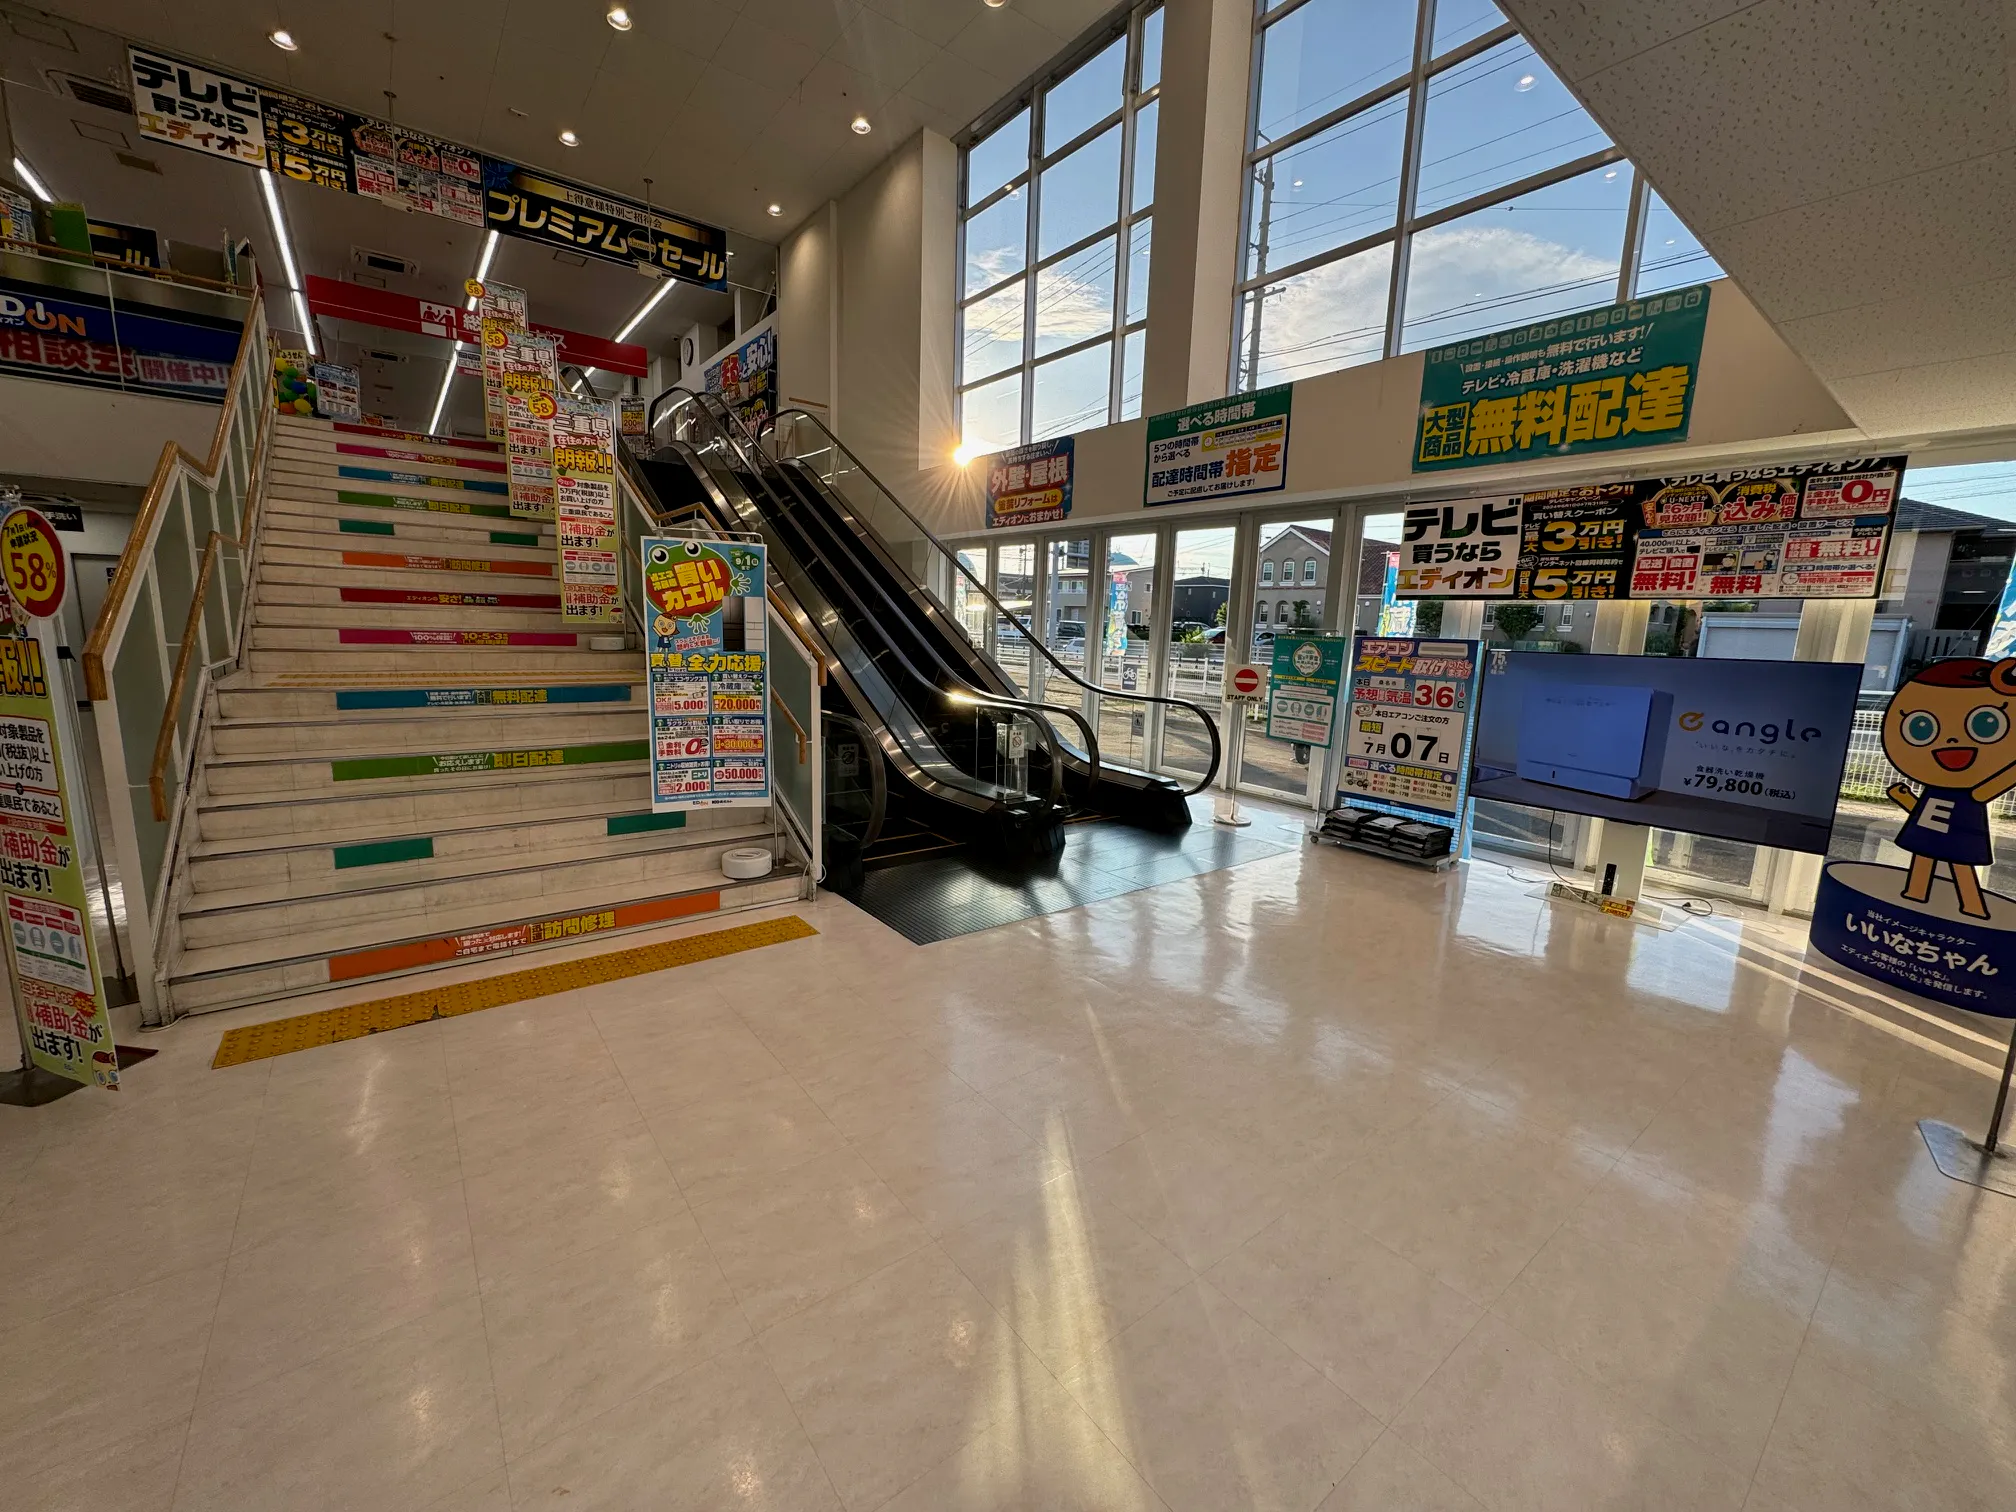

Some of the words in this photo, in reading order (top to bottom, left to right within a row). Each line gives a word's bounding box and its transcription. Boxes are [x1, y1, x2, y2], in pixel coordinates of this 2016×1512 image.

[132, 54, 260, 120] テレビ
[151, 92, 249, 136] 買うなら
[139, 110, 266, 161] エディオン
[281, 118, 309, 146] 3
[282, 152, 313, 182] 5
[487, 189, 628, 256] プレミアム
[656, 238, 726, 281] セール
[502, 344, 554, 368] 三重県
[1460, 345, 1645, 395] テレビ・冷蔵庫・洗濯機など
[1177, 400, 1257, 433] 選べる時間帯
[1426, 405, 1466, 436] 大型
[1465, 364, 1689, 458] 無料配達
[552, 412, 613, 439] 三重県
[508, 443, 542, 457] 出ます!
[1153, 435, 1200, 453] 5つの時間帯
[1153, 449, 1191, 464] から選べる
[1423, 430, 1461, 461] 商品
[553, 446, 614, 475] 朗報!!
[991, 455, 1069, 496] 外壁・屋根
[512, 500, 545, 513] 出ます!
[1523, 483, 1636, 505] 期間限定でおトク!!
[1404, 497, 1522, 542] テレビ
[1532, 507, 1619, 521] 買い替えクーポン
[1721, 496, 1779, 523] 込み
[561, 534, 599, 548] 出ます!
[1541, 519, 1577, 553] 3
[1578, 518, 1625, 538] 万円
[1412, 541, 1502, 565] 買うなら
[1577, 533, 1624, 551] 引き!
[10, 551, 58, 593] 58%
[673, 558, 722, 590] 買い
[1396, 567, 1515, 590] エディオン
[1531, 567, 1569, 600] 5
[1569, 569, 1618, 585] 万円
[1632, 571, 1697, 592] 無料!
[1709, 575, 1762, 594] 無料
[660, 580, 726, 614] カエル
[1570, 584, 1616, 600] 引き!
[566, 604, 603, 617] 出ます!
[1361, 640, 1416, 658] エアコン
[1356, 677, 1370, 687] 本日
[1246, 695, 1264, 703] ONLY
[1414, 683, 1456, 709] 36
[1360, 716, 1383, 731] 最短
[1374, 709, 1451, 726] 本日エアコンご注文の方
[1710, 718, 1823, 745] angle
[1363, 740, 1387, 756] 7月
[1389, 732, 1439, 761] 07
[1438, 751, 1451, 764] 日
[692, 771, 708, 779] ニトリ
[1695, 765, 1765, 780] 食器洗い乾燥機
[1916, 797, 1955, 834] E
[0, 857, 53, 894] 出ます!
[542, 909, 616, 941] 訪問修理
[1866, 909, 1978, 947] 当社イメージキャラクター
[1845, 912, 1999, 977] いいなちゃん
[31, 1024, 84, 1064] 出ます!
